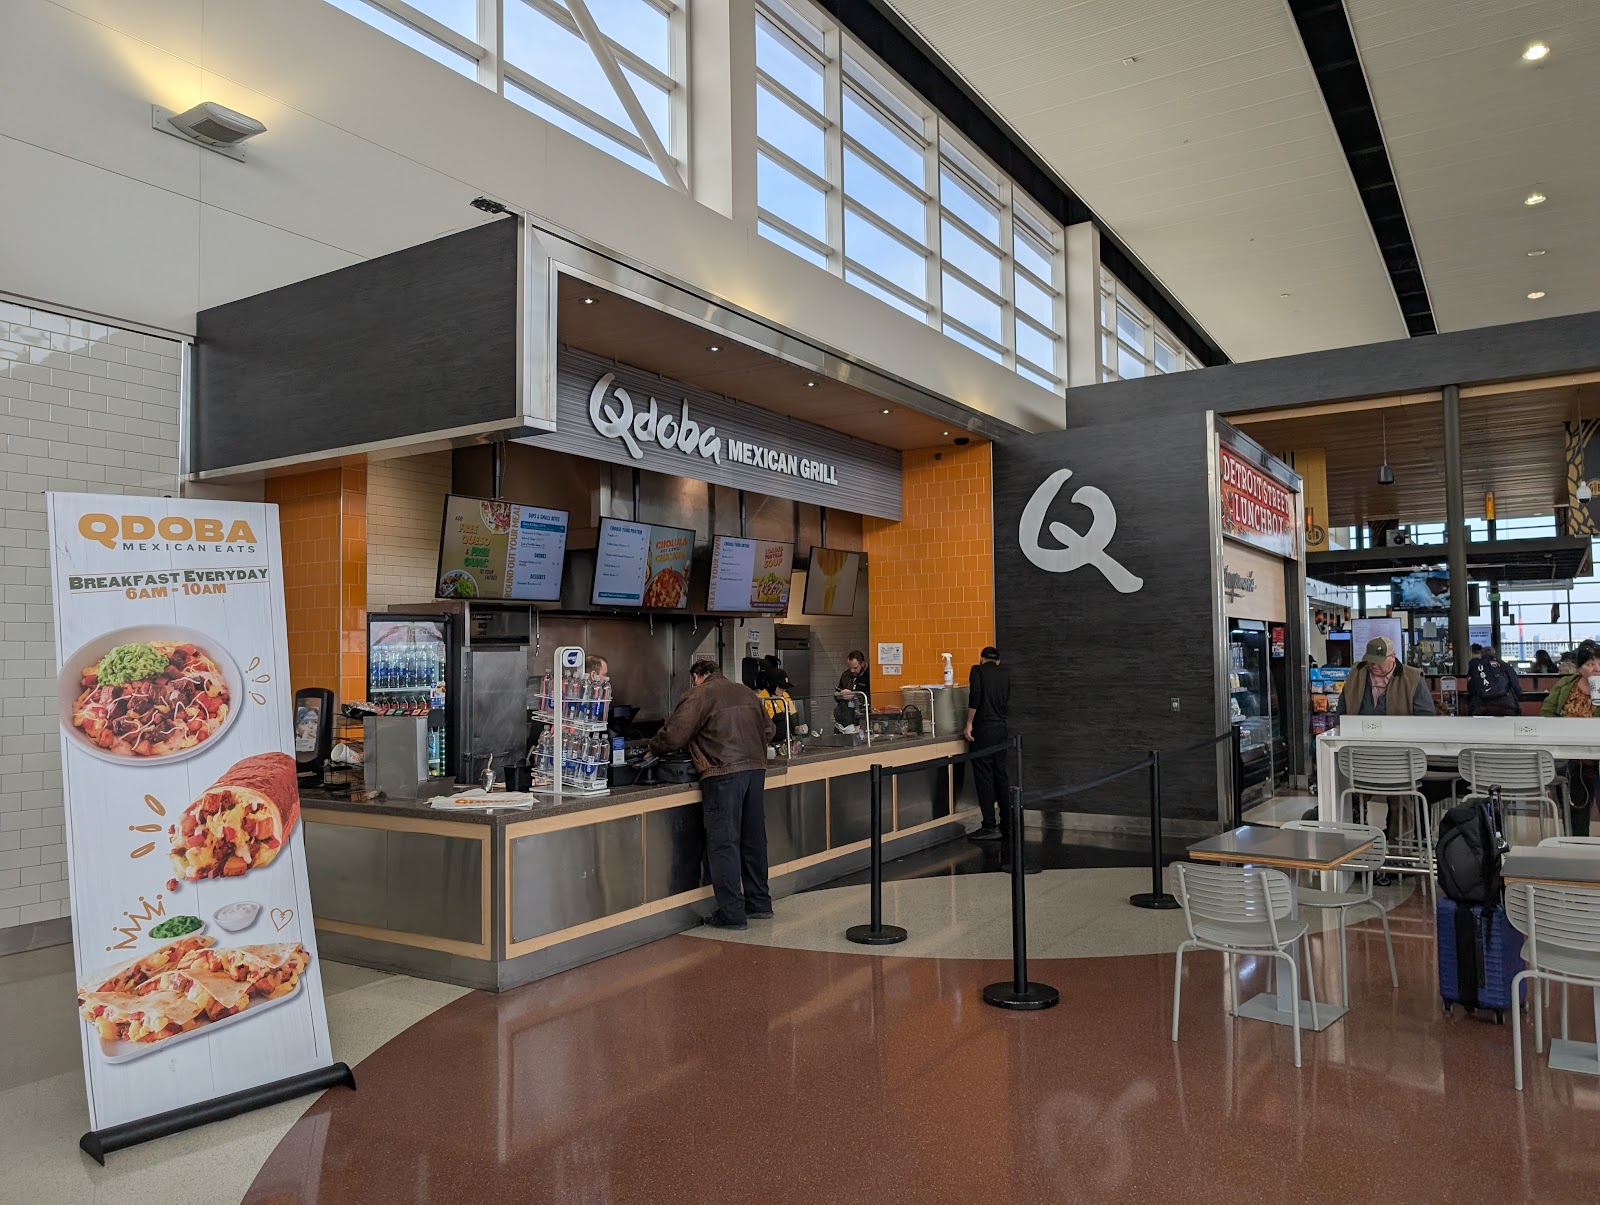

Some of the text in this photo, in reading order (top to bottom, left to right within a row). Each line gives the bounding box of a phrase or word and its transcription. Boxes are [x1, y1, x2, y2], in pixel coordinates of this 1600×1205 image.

[590, 373, 838, 486] Qdoba MEXICAN GRILL
[1223, 454, 1289, 515] DETROIT STREET
[78, 513, 258, 550] QDOBA
[1019, 468, 1143, 593] Q
[1234, 493, 1284, 539] LUNCHBOX
[122, 542, 255, 553] MEXICAN EATS
[505, 506, 520, 598] ROUND OUT YOUR MEAL
[764, 558, 782, 568] SOUP
[69, 569, 268, 590] BREAKFAST EVERYDAY
[712, 558, 720, 580] YOUR
[126, 586, 168, 600] 6AM
[182, 583, 227, 596] 10AM
[709, 582, 717, 610] CREATE
